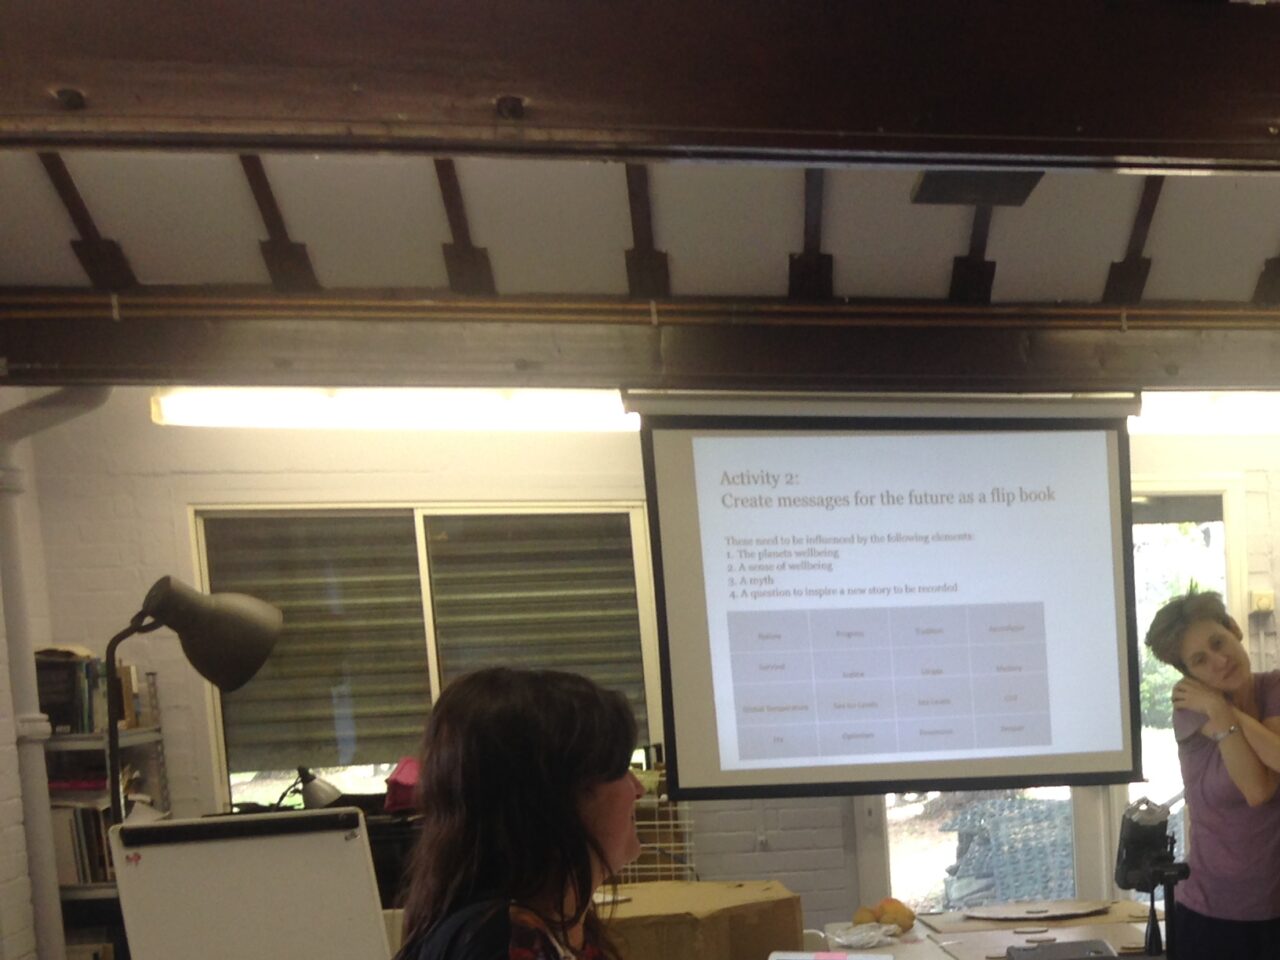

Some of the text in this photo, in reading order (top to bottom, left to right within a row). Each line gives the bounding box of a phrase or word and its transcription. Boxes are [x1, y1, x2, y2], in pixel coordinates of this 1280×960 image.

[720, 470, 800, 488] Activity 2:
[721, 486, 1056, 511] Create messages for the future as a flip book
[756, 535, 778, 546] need
[780, 536, 790, 546] to
[792, 535, 804, 545] be
[806, 534, 854, 545] influenced
[857, 534, 868, 546] by
[870, 533, 886, 544] the
[887, 532, 929, 545] following
[737, 549, 756, 560] The
[758, 550, 793, 561] planets
[794, 548, 840, 560] wellbeing
[738, 562, 746, 572] A
[776, 562, 787, 571] of
[788, 560, 833, 572] wellbeing
[739, 576, 747, 585] A
[749, 574, 774, 587] myth
[729, 590, 738, 600] 4.
[741, 588, 748, 598] A
[750, 587, 792, 600] question
[793, 588, 803, 597] to
[805, 586, 838, 599] inspire
[847, 587, 867, 596] new
[868, 586, 891, 597] story
[893, 585, 904, 594] to
[905, 583, 916, 593] be
[918, 581, 958, 593] recorded
